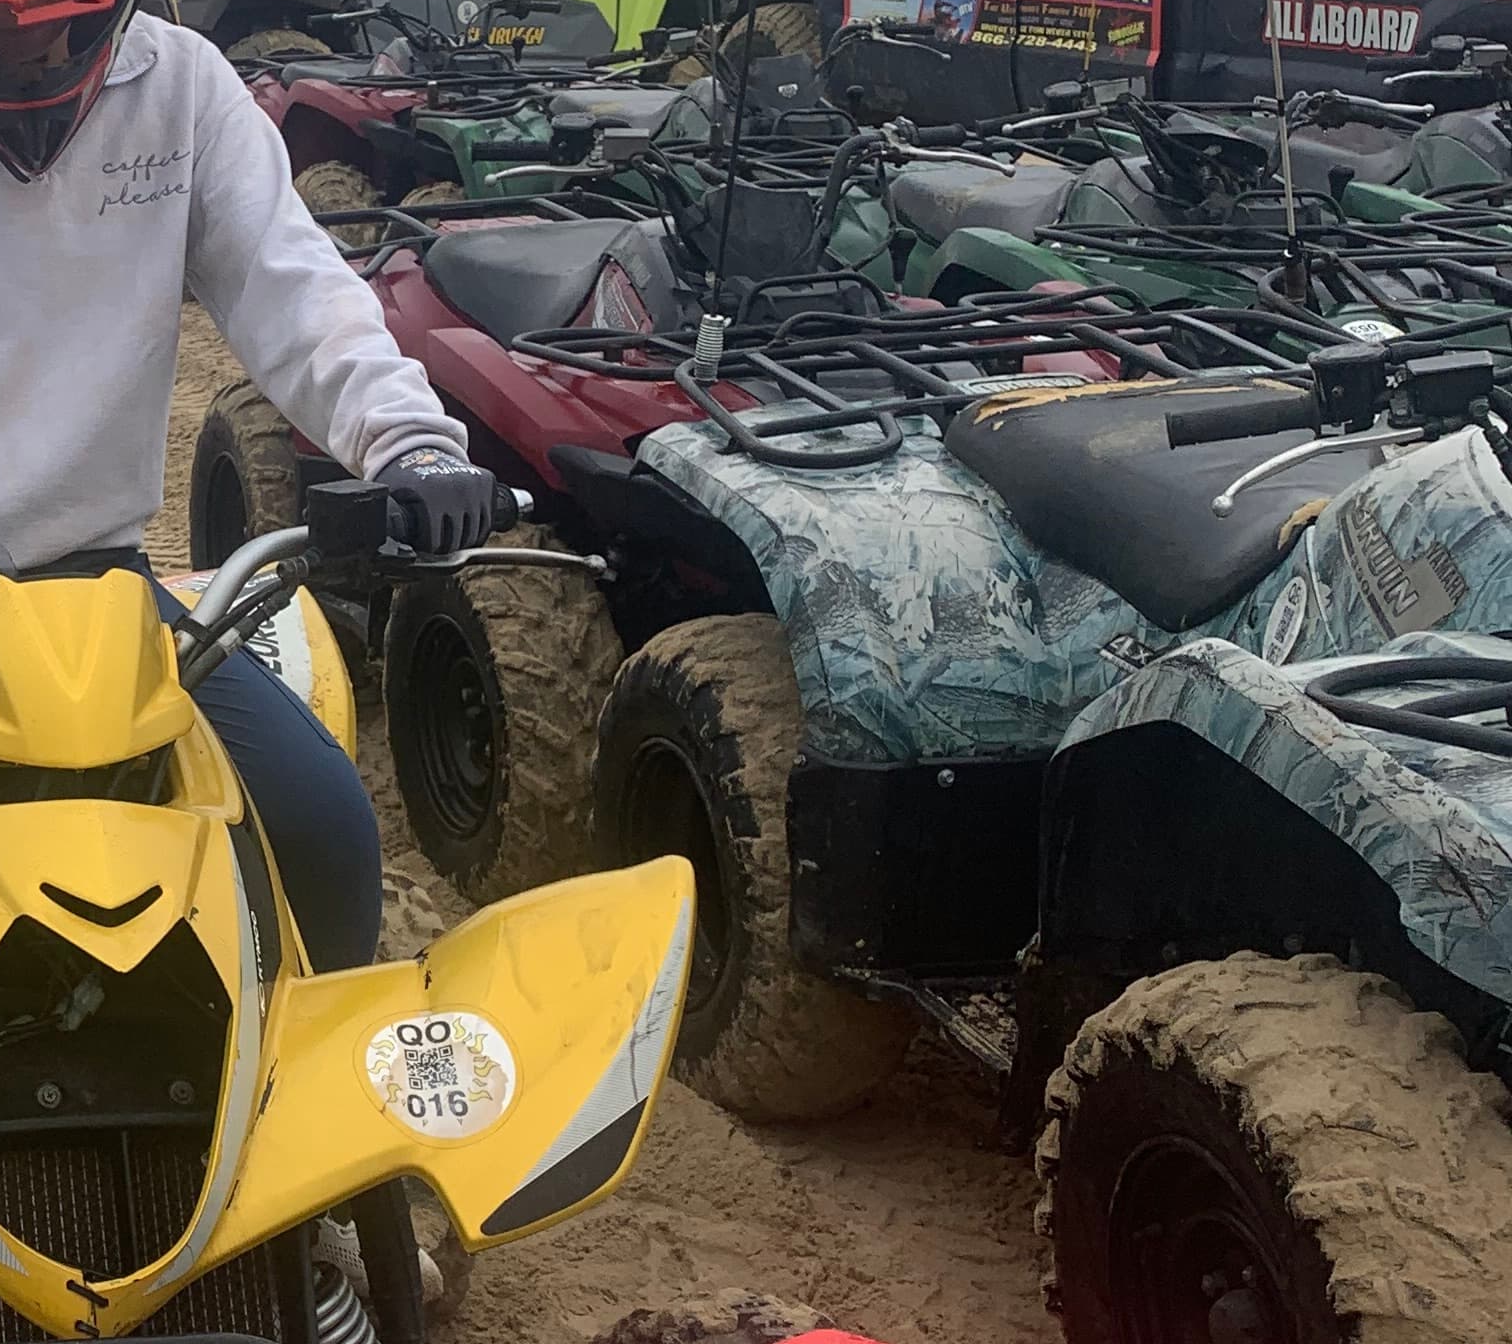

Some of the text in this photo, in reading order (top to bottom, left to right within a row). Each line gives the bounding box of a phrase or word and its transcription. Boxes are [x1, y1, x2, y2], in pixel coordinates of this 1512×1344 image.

[1266, 0, 1419, 53] ALL ABOARD
[102, 150, 190, 181] coffee
[98, 183, 189, 216] please
[1426, 540, 1470, 606] YAMAHA
[396, 1020, 451, 1046] QO
[407, 1090, 469, 1118] 016
